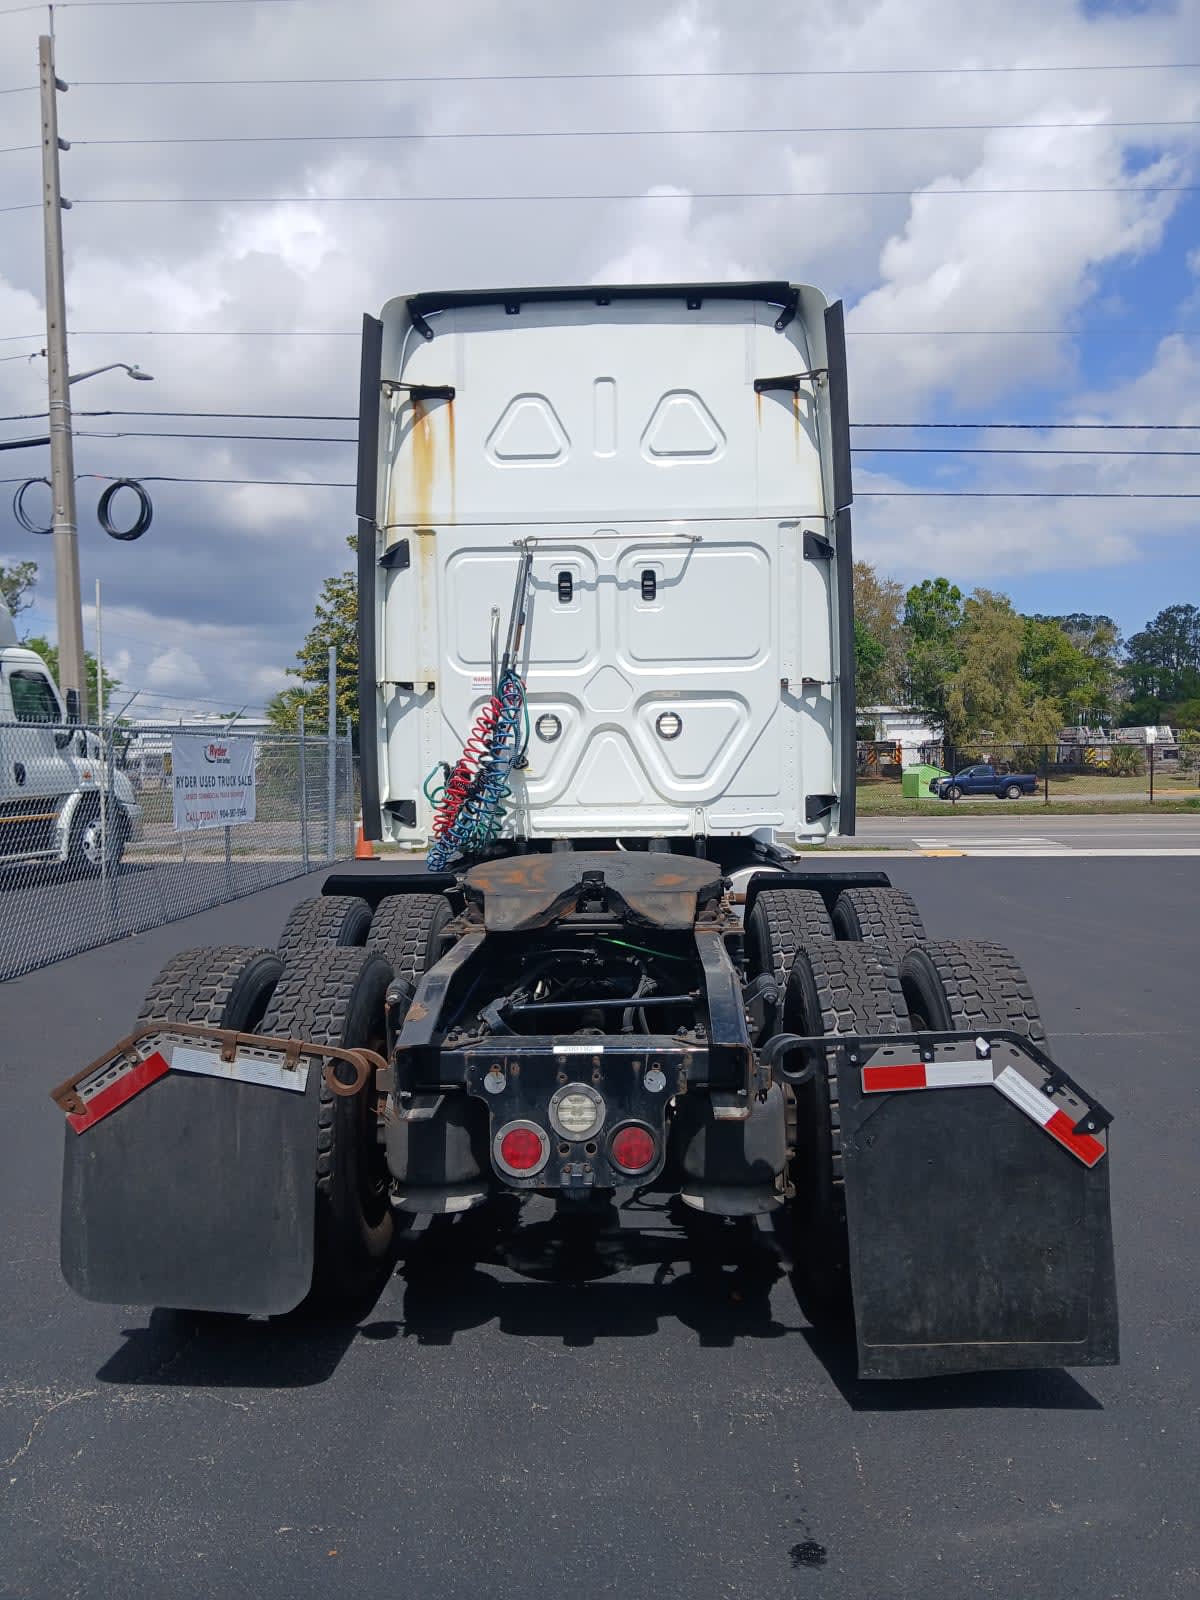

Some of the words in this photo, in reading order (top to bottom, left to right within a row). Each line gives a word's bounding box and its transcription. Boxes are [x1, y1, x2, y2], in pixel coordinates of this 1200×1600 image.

[209, 744, 227, 759] Ryder
[176, 776, 197, 788] RYDER
[199, 775, 216, 788] USED
[217, 775, 236, 788] TRUCK
